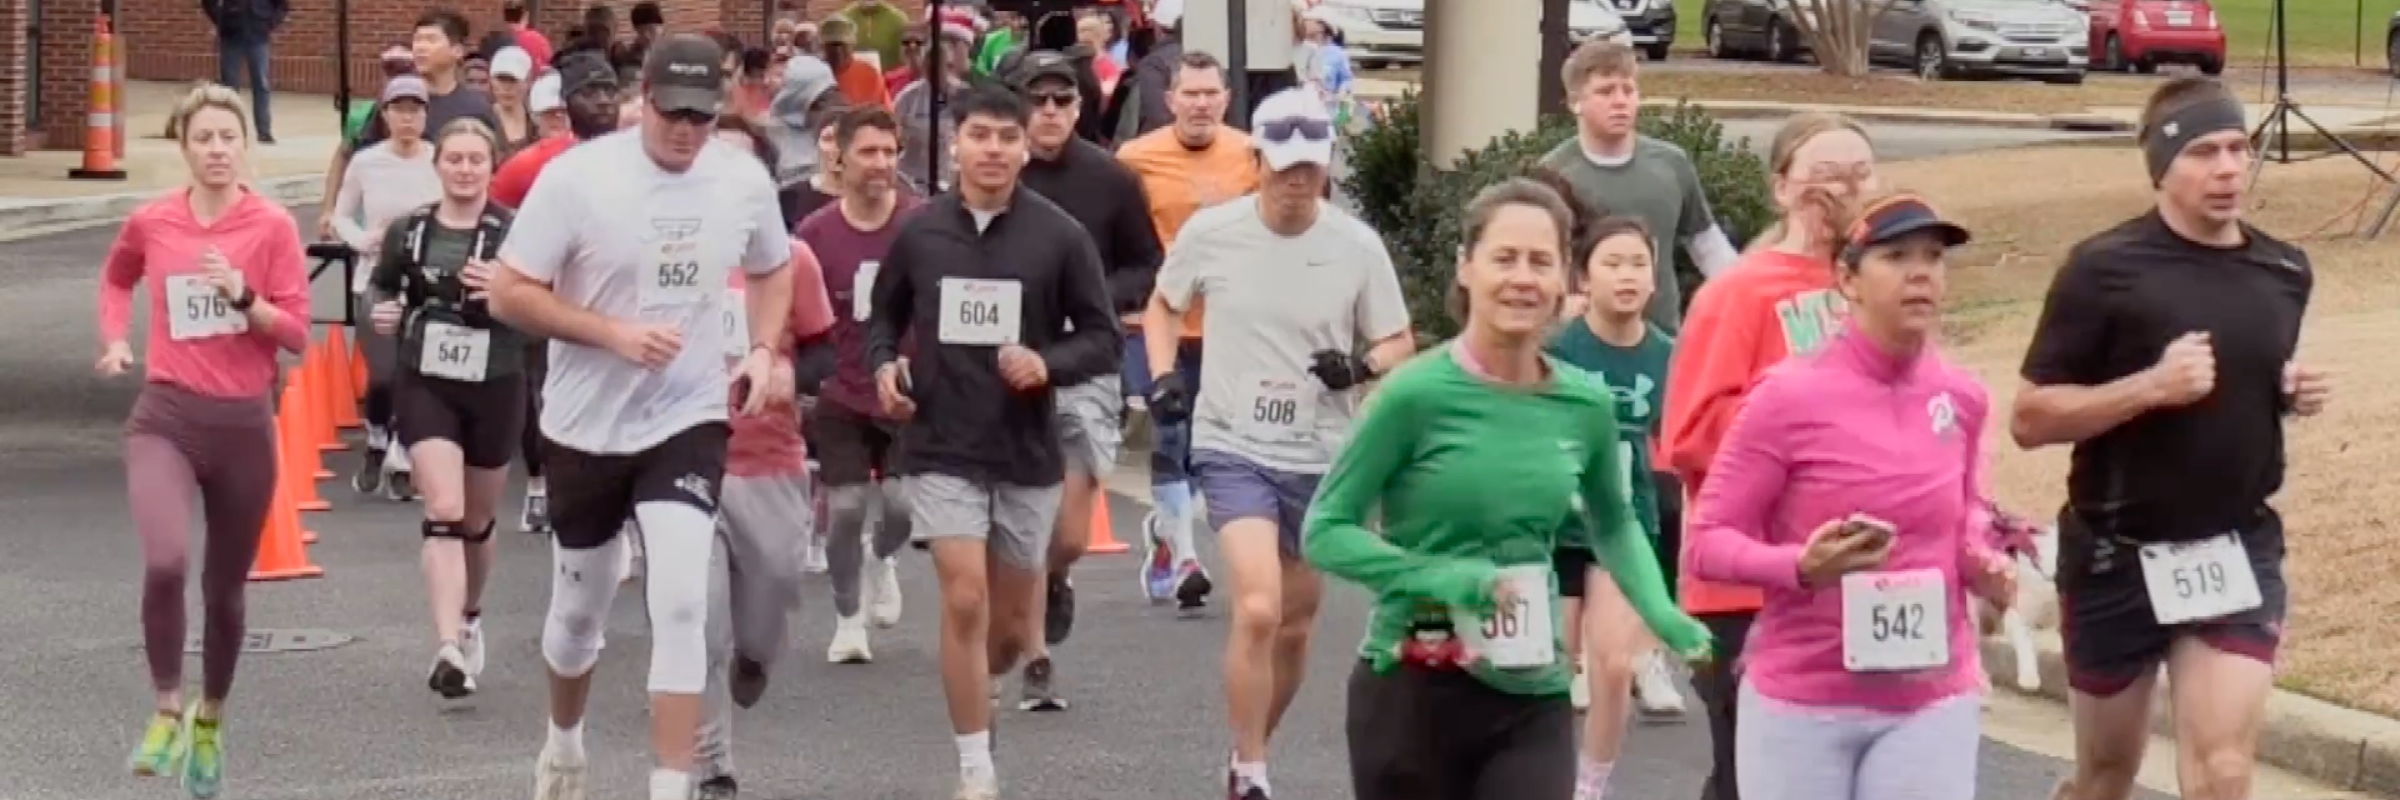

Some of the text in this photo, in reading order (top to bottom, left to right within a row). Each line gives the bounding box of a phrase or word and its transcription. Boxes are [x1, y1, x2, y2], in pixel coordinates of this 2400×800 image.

[658, 261, 699, 288] 552
[187, 294, 227, 321] 576
[960, 300, 999, 327] 604
[439, 341, 472, 366] 547
[1253, 396, 1297, 426] 508
[2172, 561, 2226, 600] 519
[1871, 602, 1926, 642] 542
